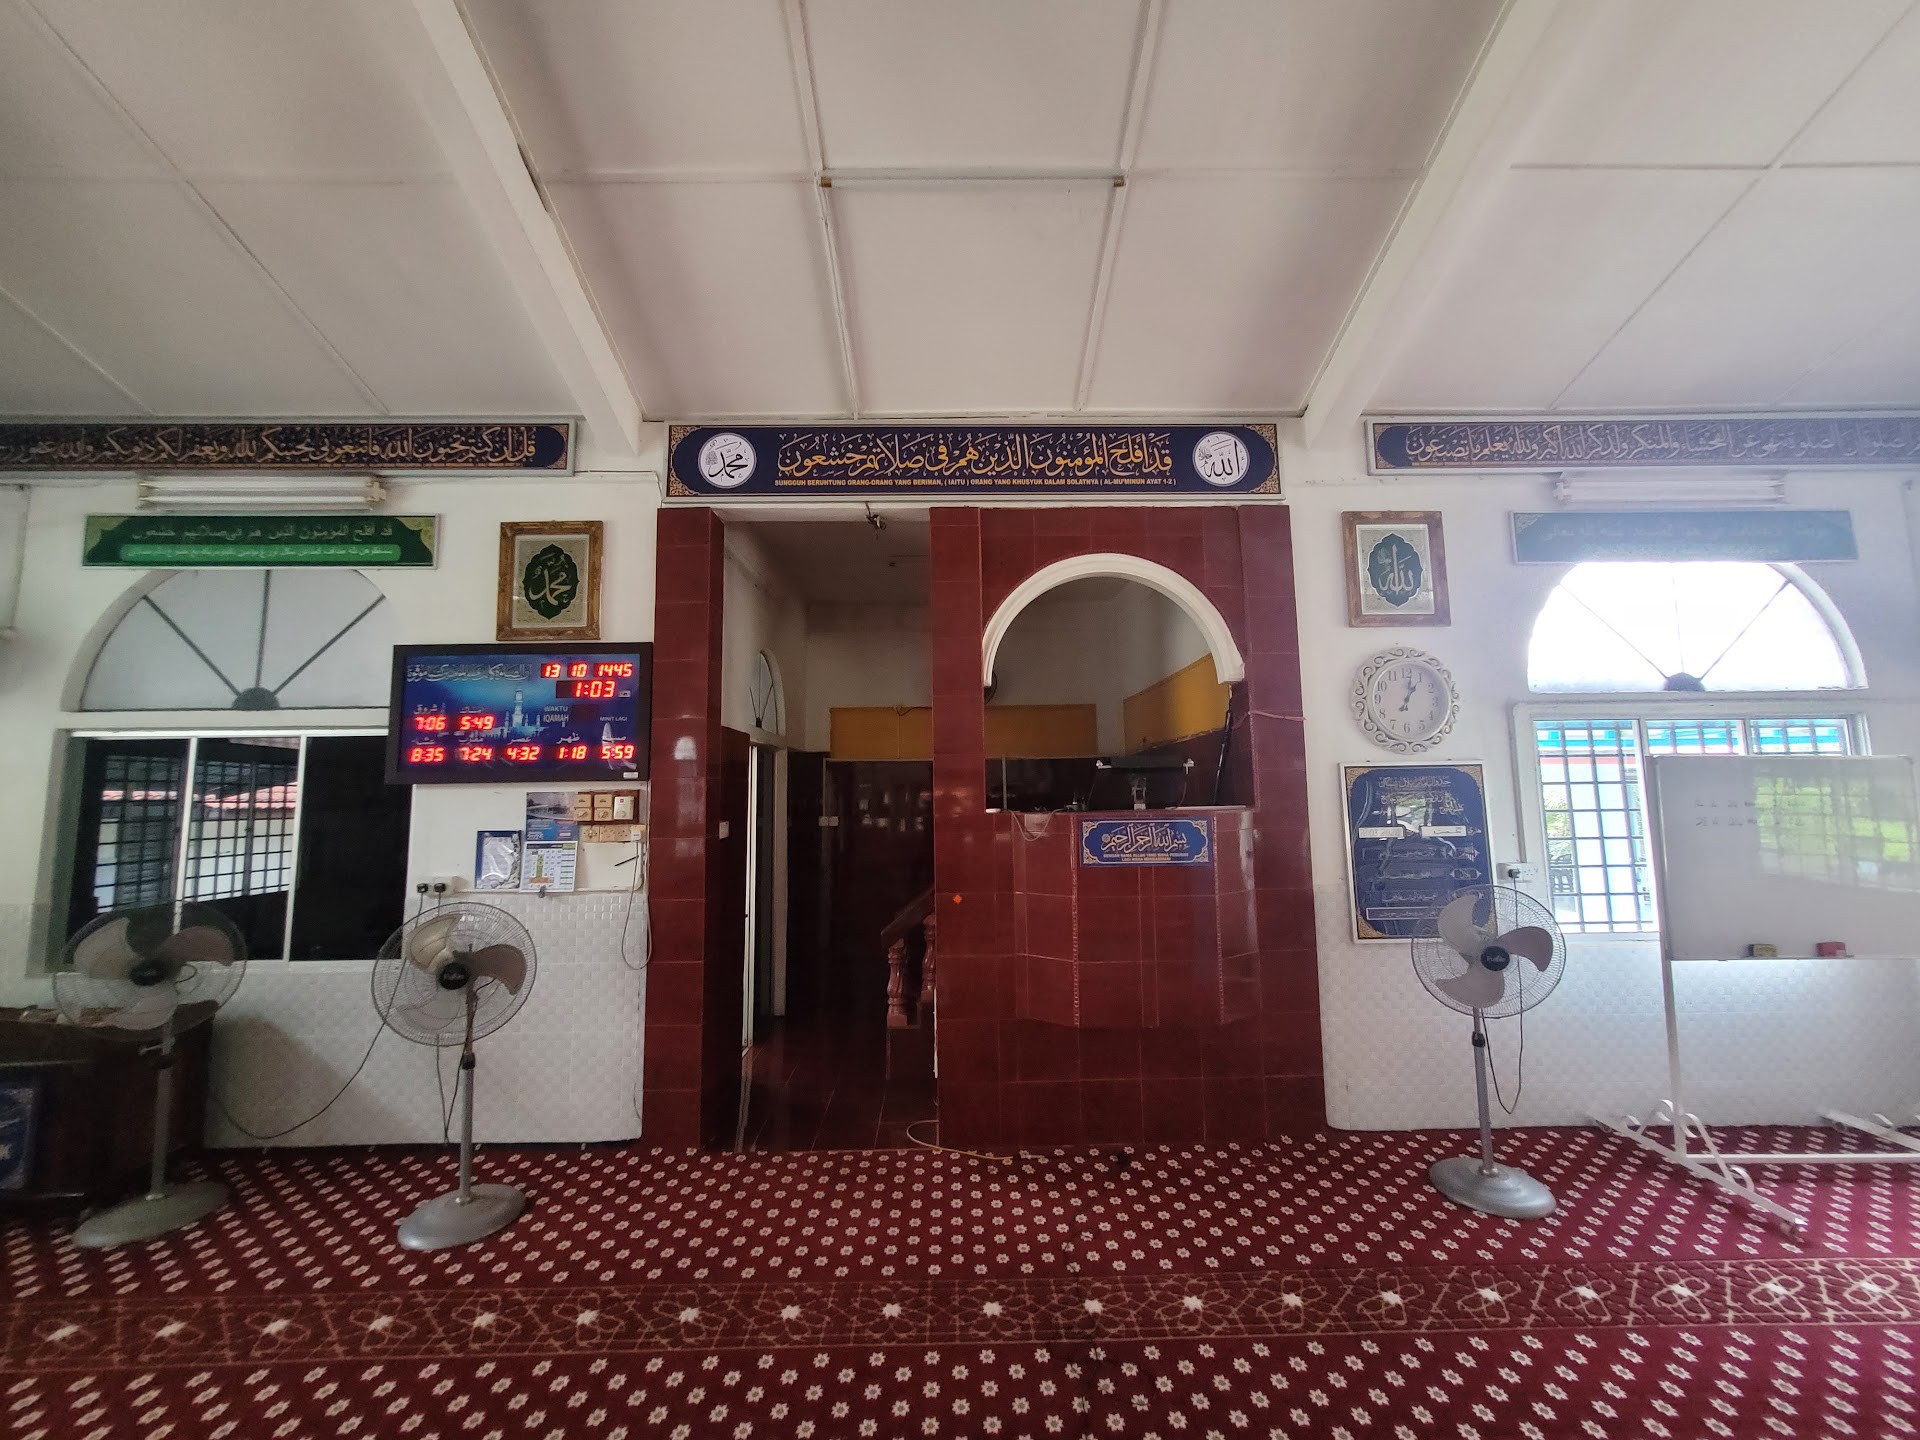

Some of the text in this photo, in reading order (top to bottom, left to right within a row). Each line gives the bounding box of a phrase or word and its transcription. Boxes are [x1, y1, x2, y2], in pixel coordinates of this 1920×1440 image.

[380, 427, 413, 460] الله
[774, 479, 806, 487] SUNGGUH
[807, 479, 846, 487] BERUNTUNG
[847, 479, 893, 487] ORANG-ORANG
[545, 663, 562, 678] 13
[571, 663, 588, 678] 10
[598, 663, 633, 678] 1445
[575, 680, 616, 698] 1:03
[414, 716, 447, 731] 7:06
[459, 715, 495, 730] 5:49
[543, 714, 569, 723] IQAMAH
[410, 747, 445, 762] 8:35
[460, 746, 493, 761] 7:24
[506, 746, 541, 761] 4:32
[559, 745, 588, 760] 1:18
[601, 744, 635, 760] 5:59
